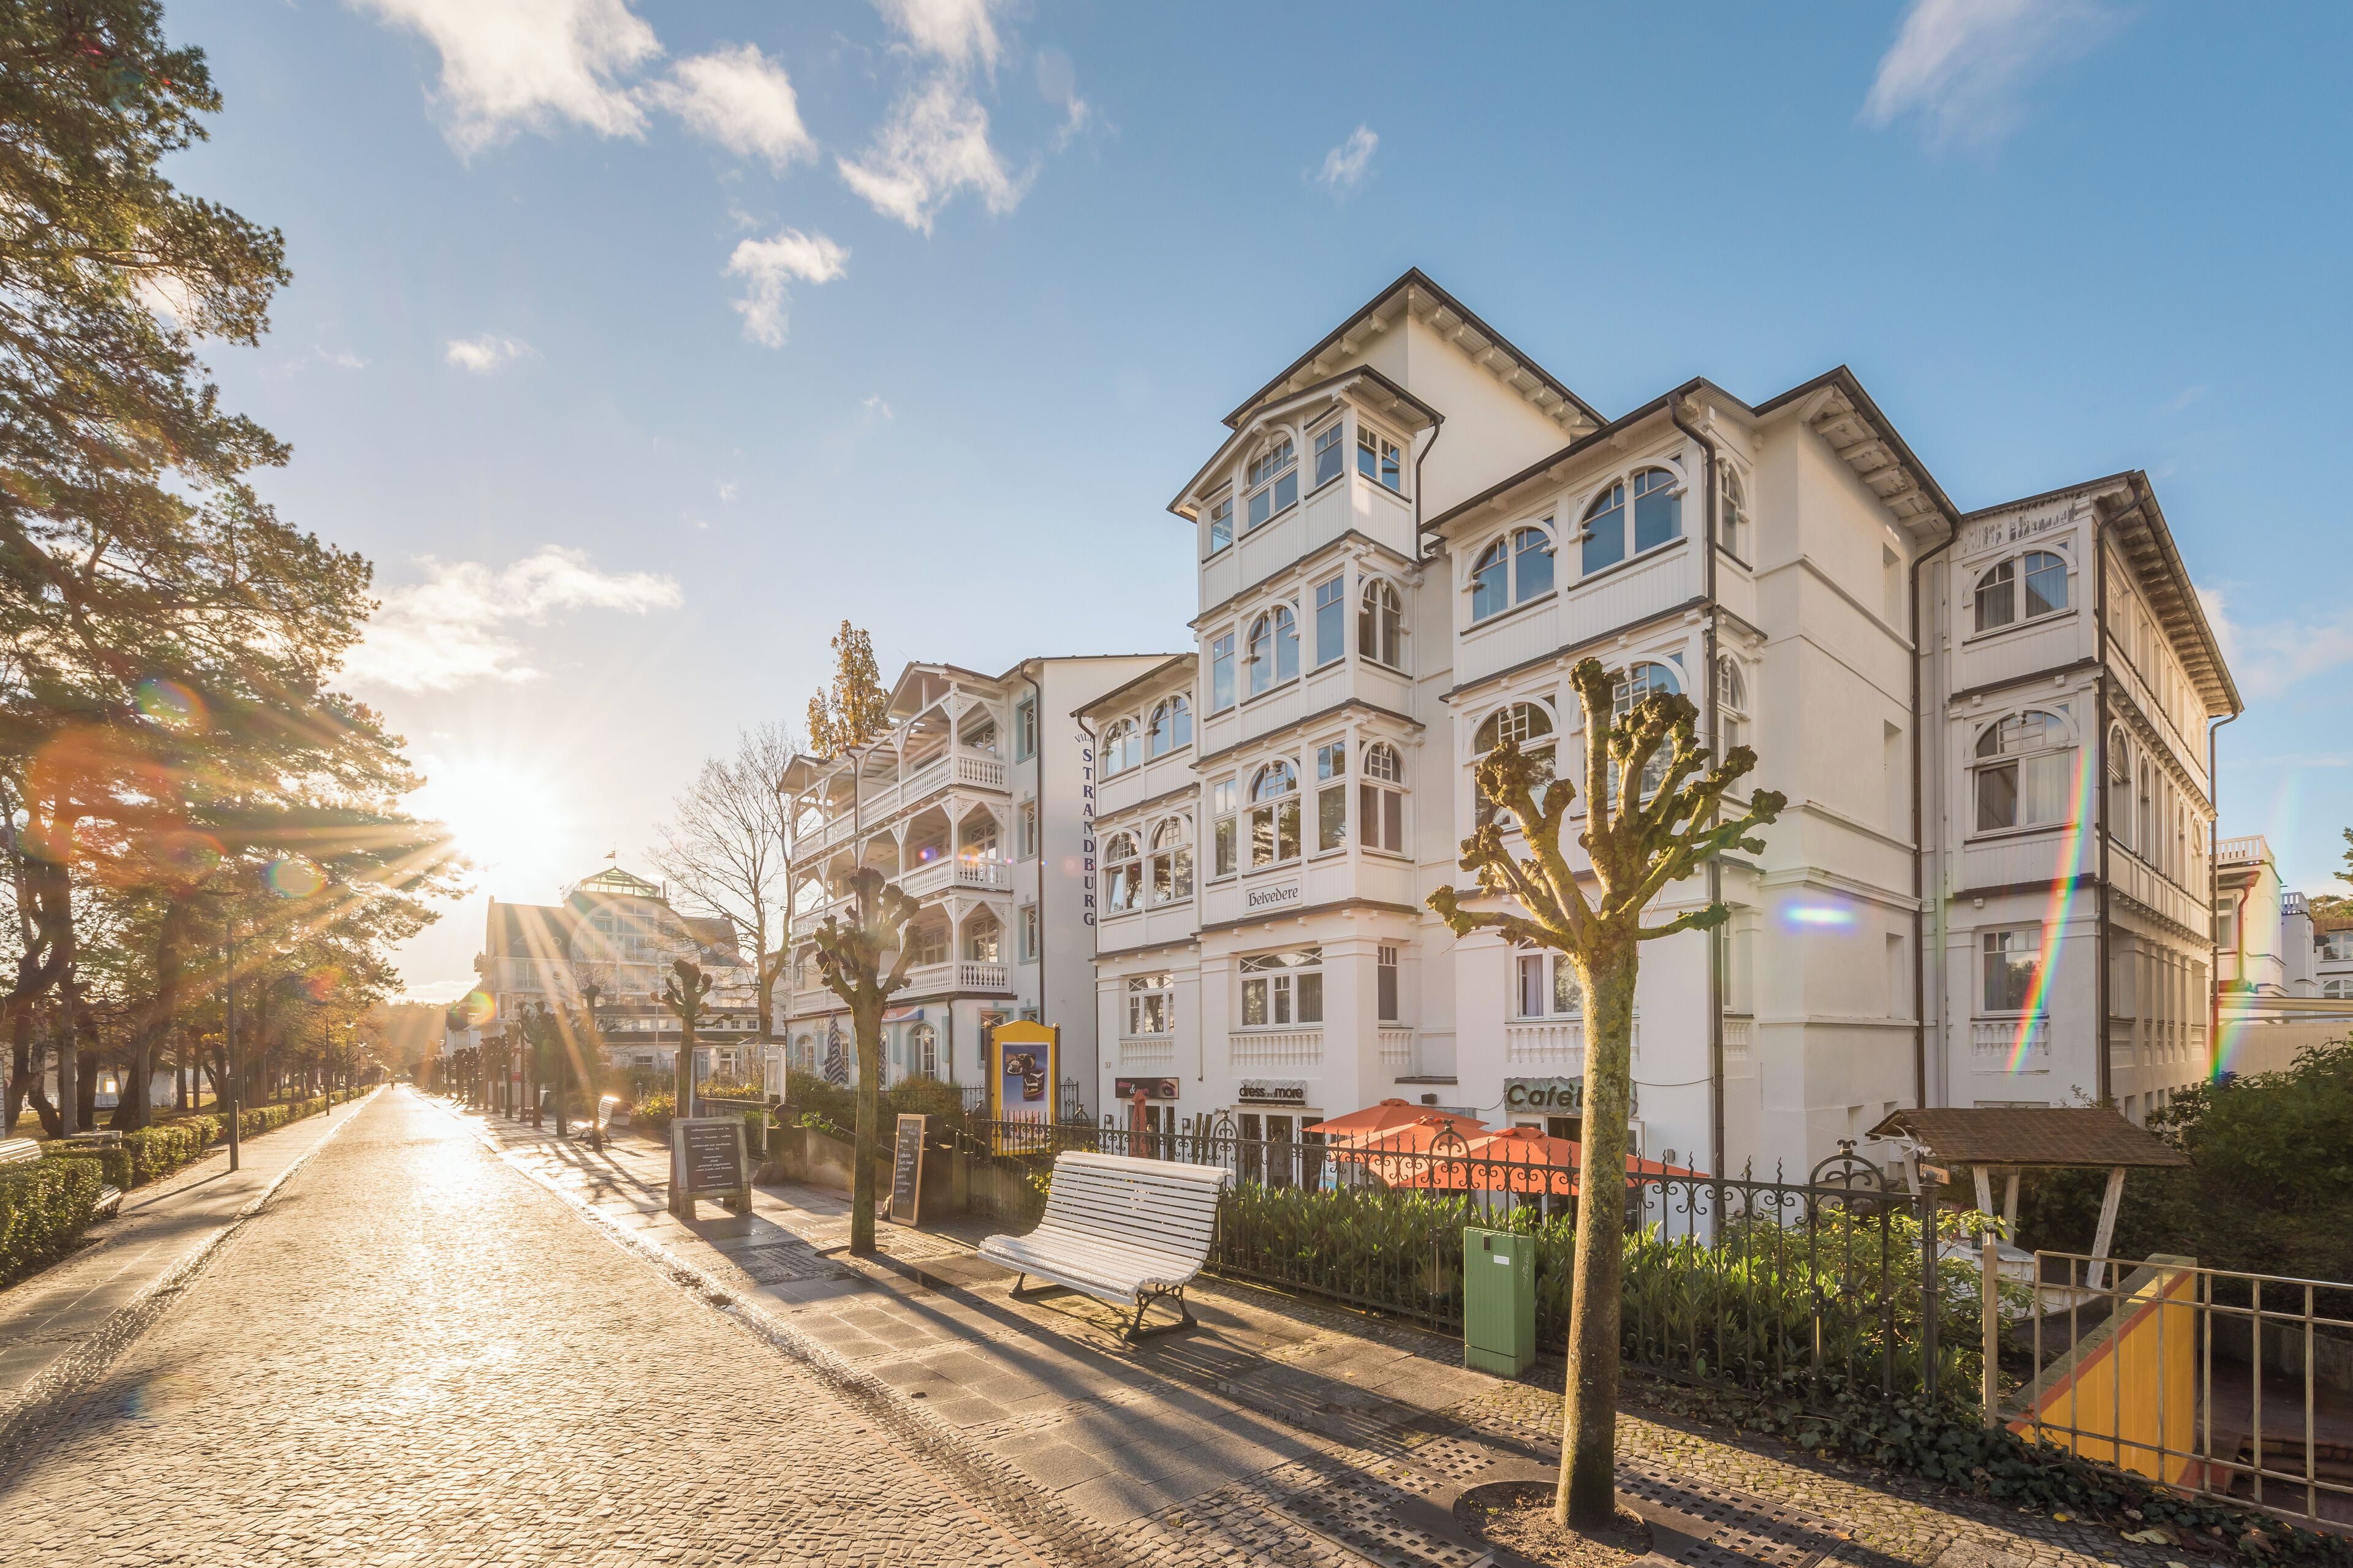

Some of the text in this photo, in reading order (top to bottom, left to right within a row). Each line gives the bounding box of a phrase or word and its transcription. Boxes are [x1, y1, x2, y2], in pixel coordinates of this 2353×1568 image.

[1074, 733, 1094, 743] VILL
[1082, 748, 1095, 926] STRANDBURG
[1248, 887, 1298, 907] Belvedere
[1129, 1084, 1135, 1094] &
[1239, 1085, 1265, 1097] dress
[1275, 1088, 1303, 1099] more
